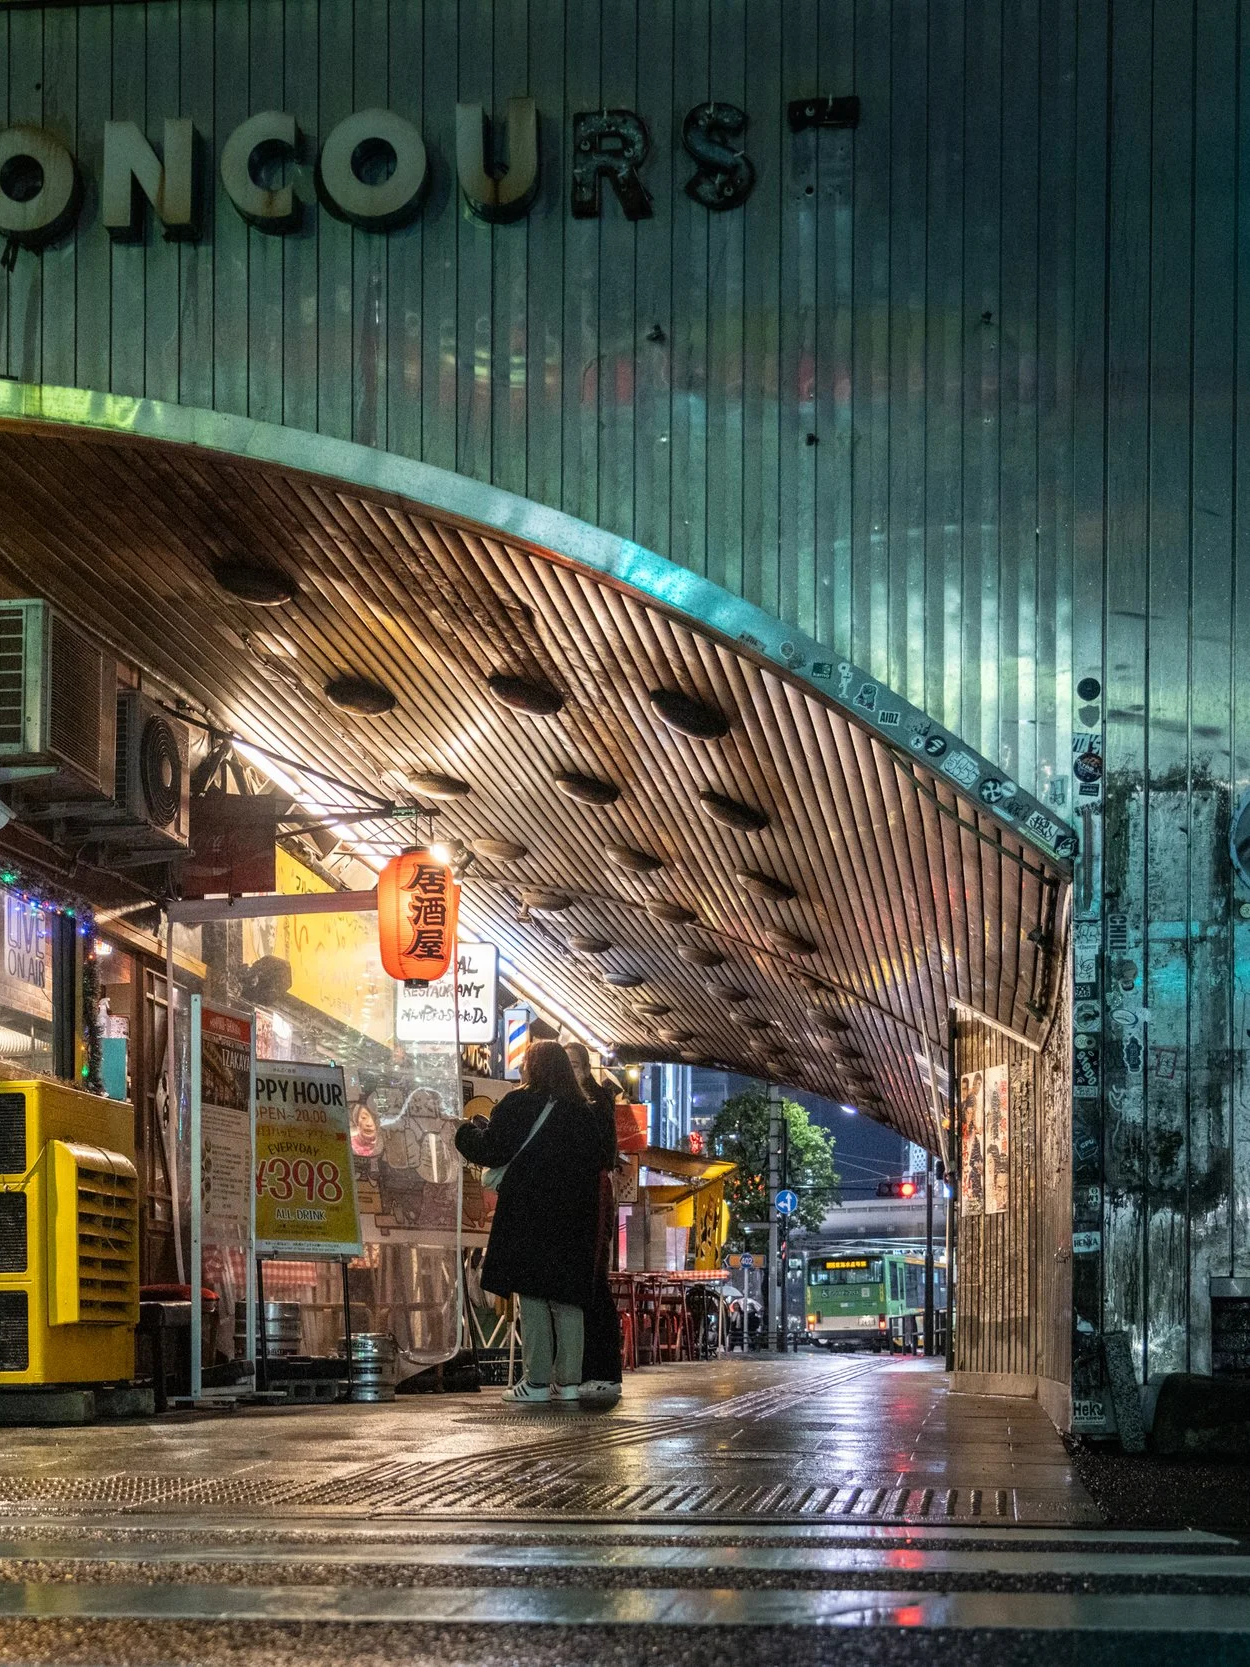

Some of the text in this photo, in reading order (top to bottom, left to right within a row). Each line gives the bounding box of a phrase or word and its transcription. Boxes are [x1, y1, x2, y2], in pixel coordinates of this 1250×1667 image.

[879, 711, 899, 725] AIDZ
[407, 863, 447, 961] 居酒屋
[7, 896, 45, 960] LIVE
[8, 948, 46, 989] ON AIR
[292, 1081, 343, 1106] HOUR
[267, 1141, 320, 1157] EVERYDAY
[276, 1208, 327, 1221] ALL DRINK
[741, 1257, 753, 1265] 402
